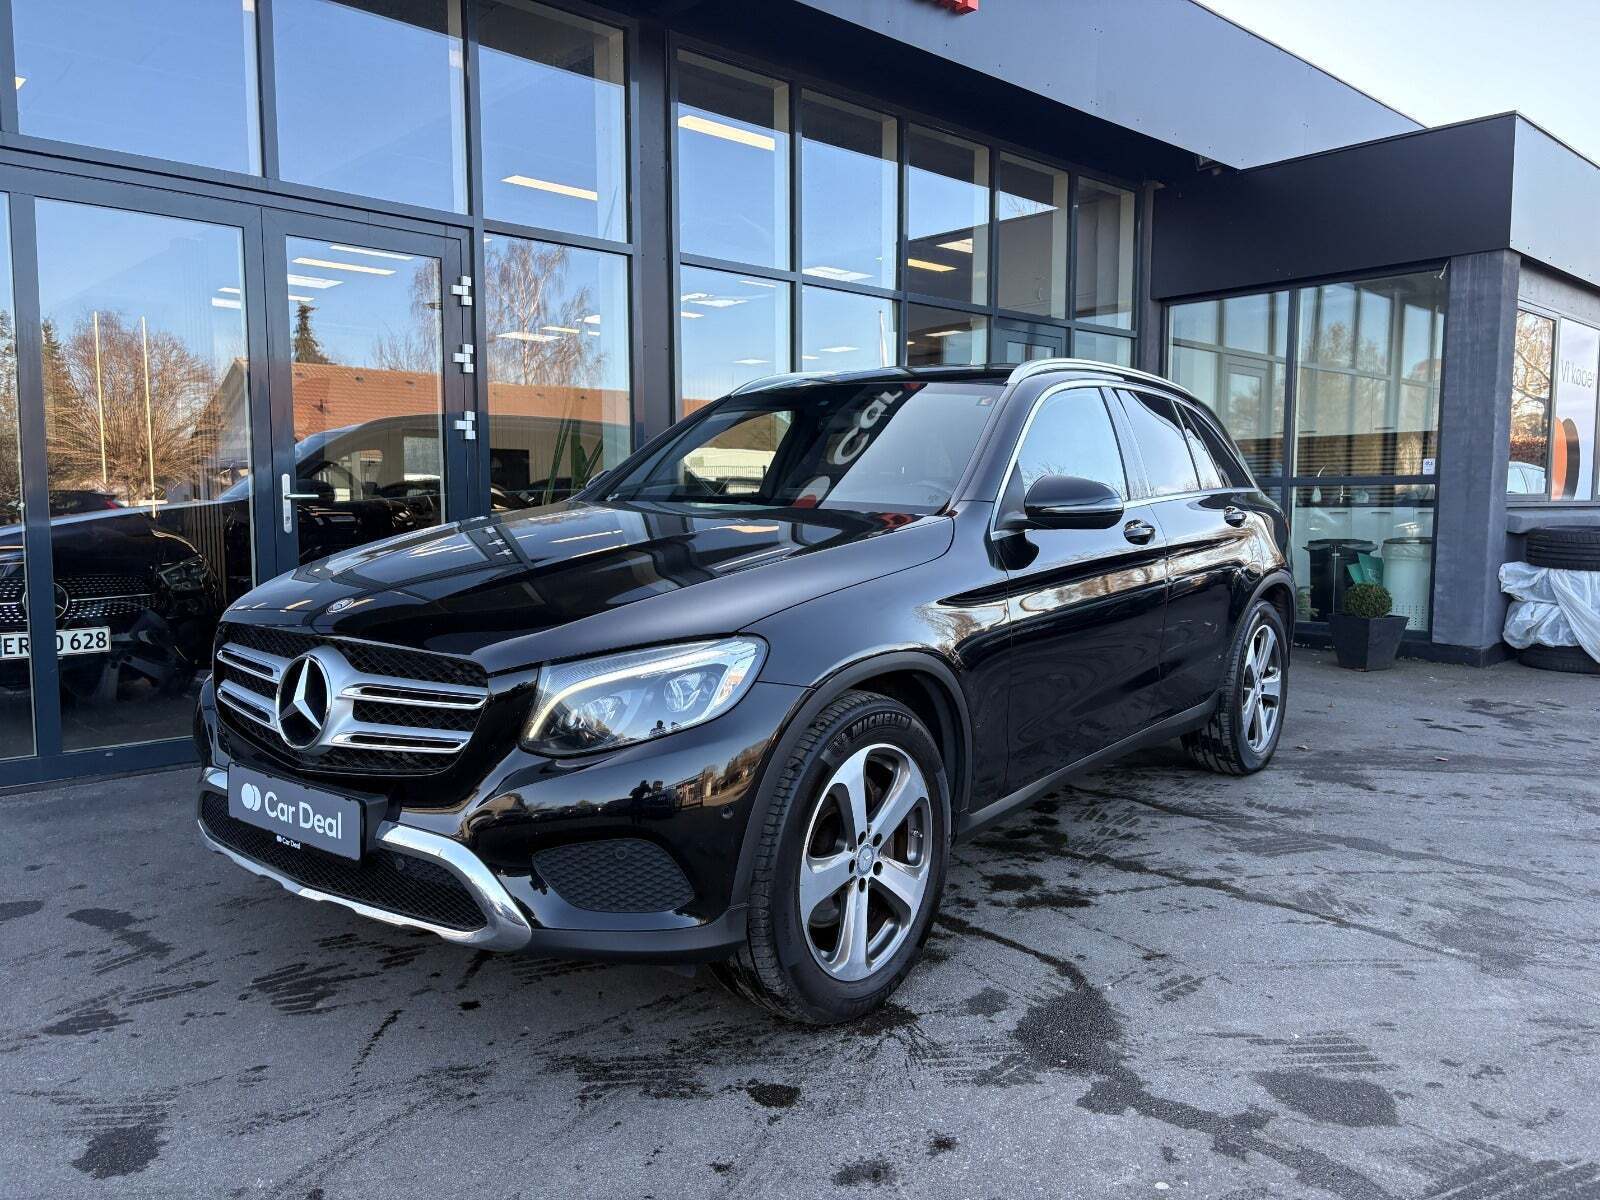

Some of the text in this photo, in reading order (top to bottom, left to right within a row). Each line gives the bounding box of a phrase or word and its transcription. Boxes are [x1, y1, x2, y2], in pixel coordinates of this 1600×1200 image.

[3, 637, 30, 655] ER
[70, 631, 107, 651] 628
[851, 713, 911, 738] MICHELIN
[264, 791, 342, 840] Car Deal
